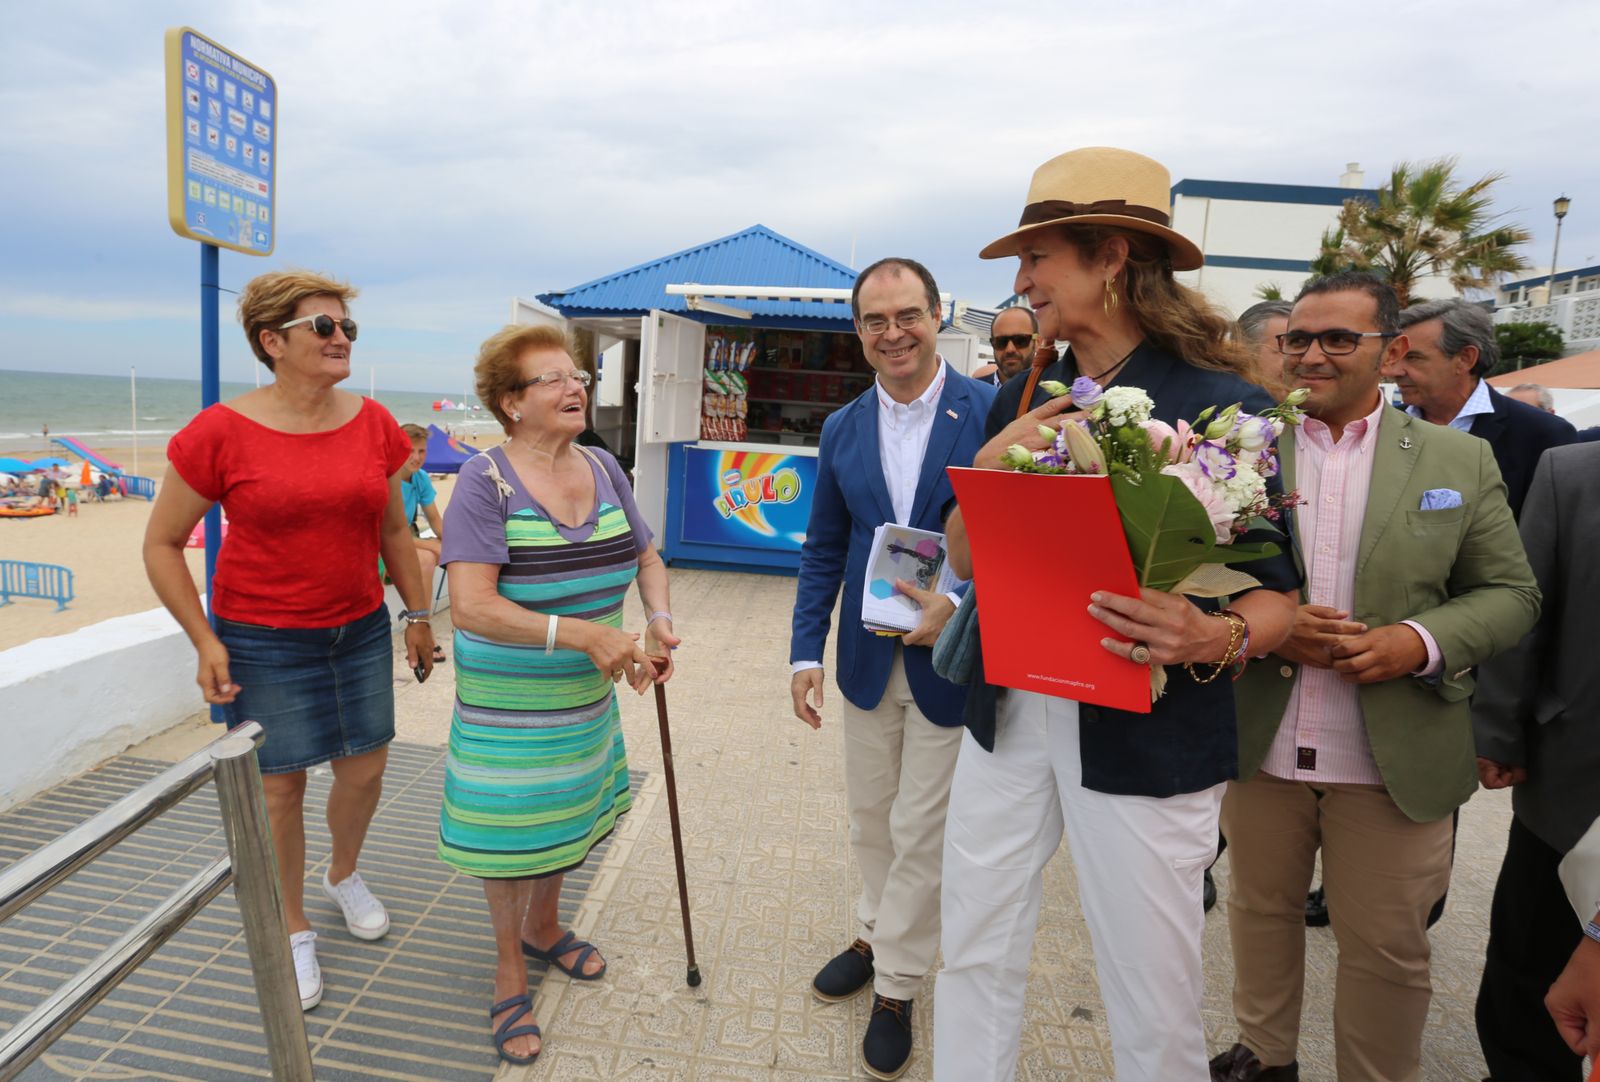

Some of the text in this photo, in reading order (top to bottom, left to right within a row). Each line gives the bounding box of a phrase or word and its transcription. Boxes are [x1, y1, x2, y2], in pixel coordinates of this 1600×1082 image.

[190, 35, 231, 68] NORMATIVA
[231, 58, 267, 88] MUNICIPAL
[712, 467, 801, 519] PIRULO
